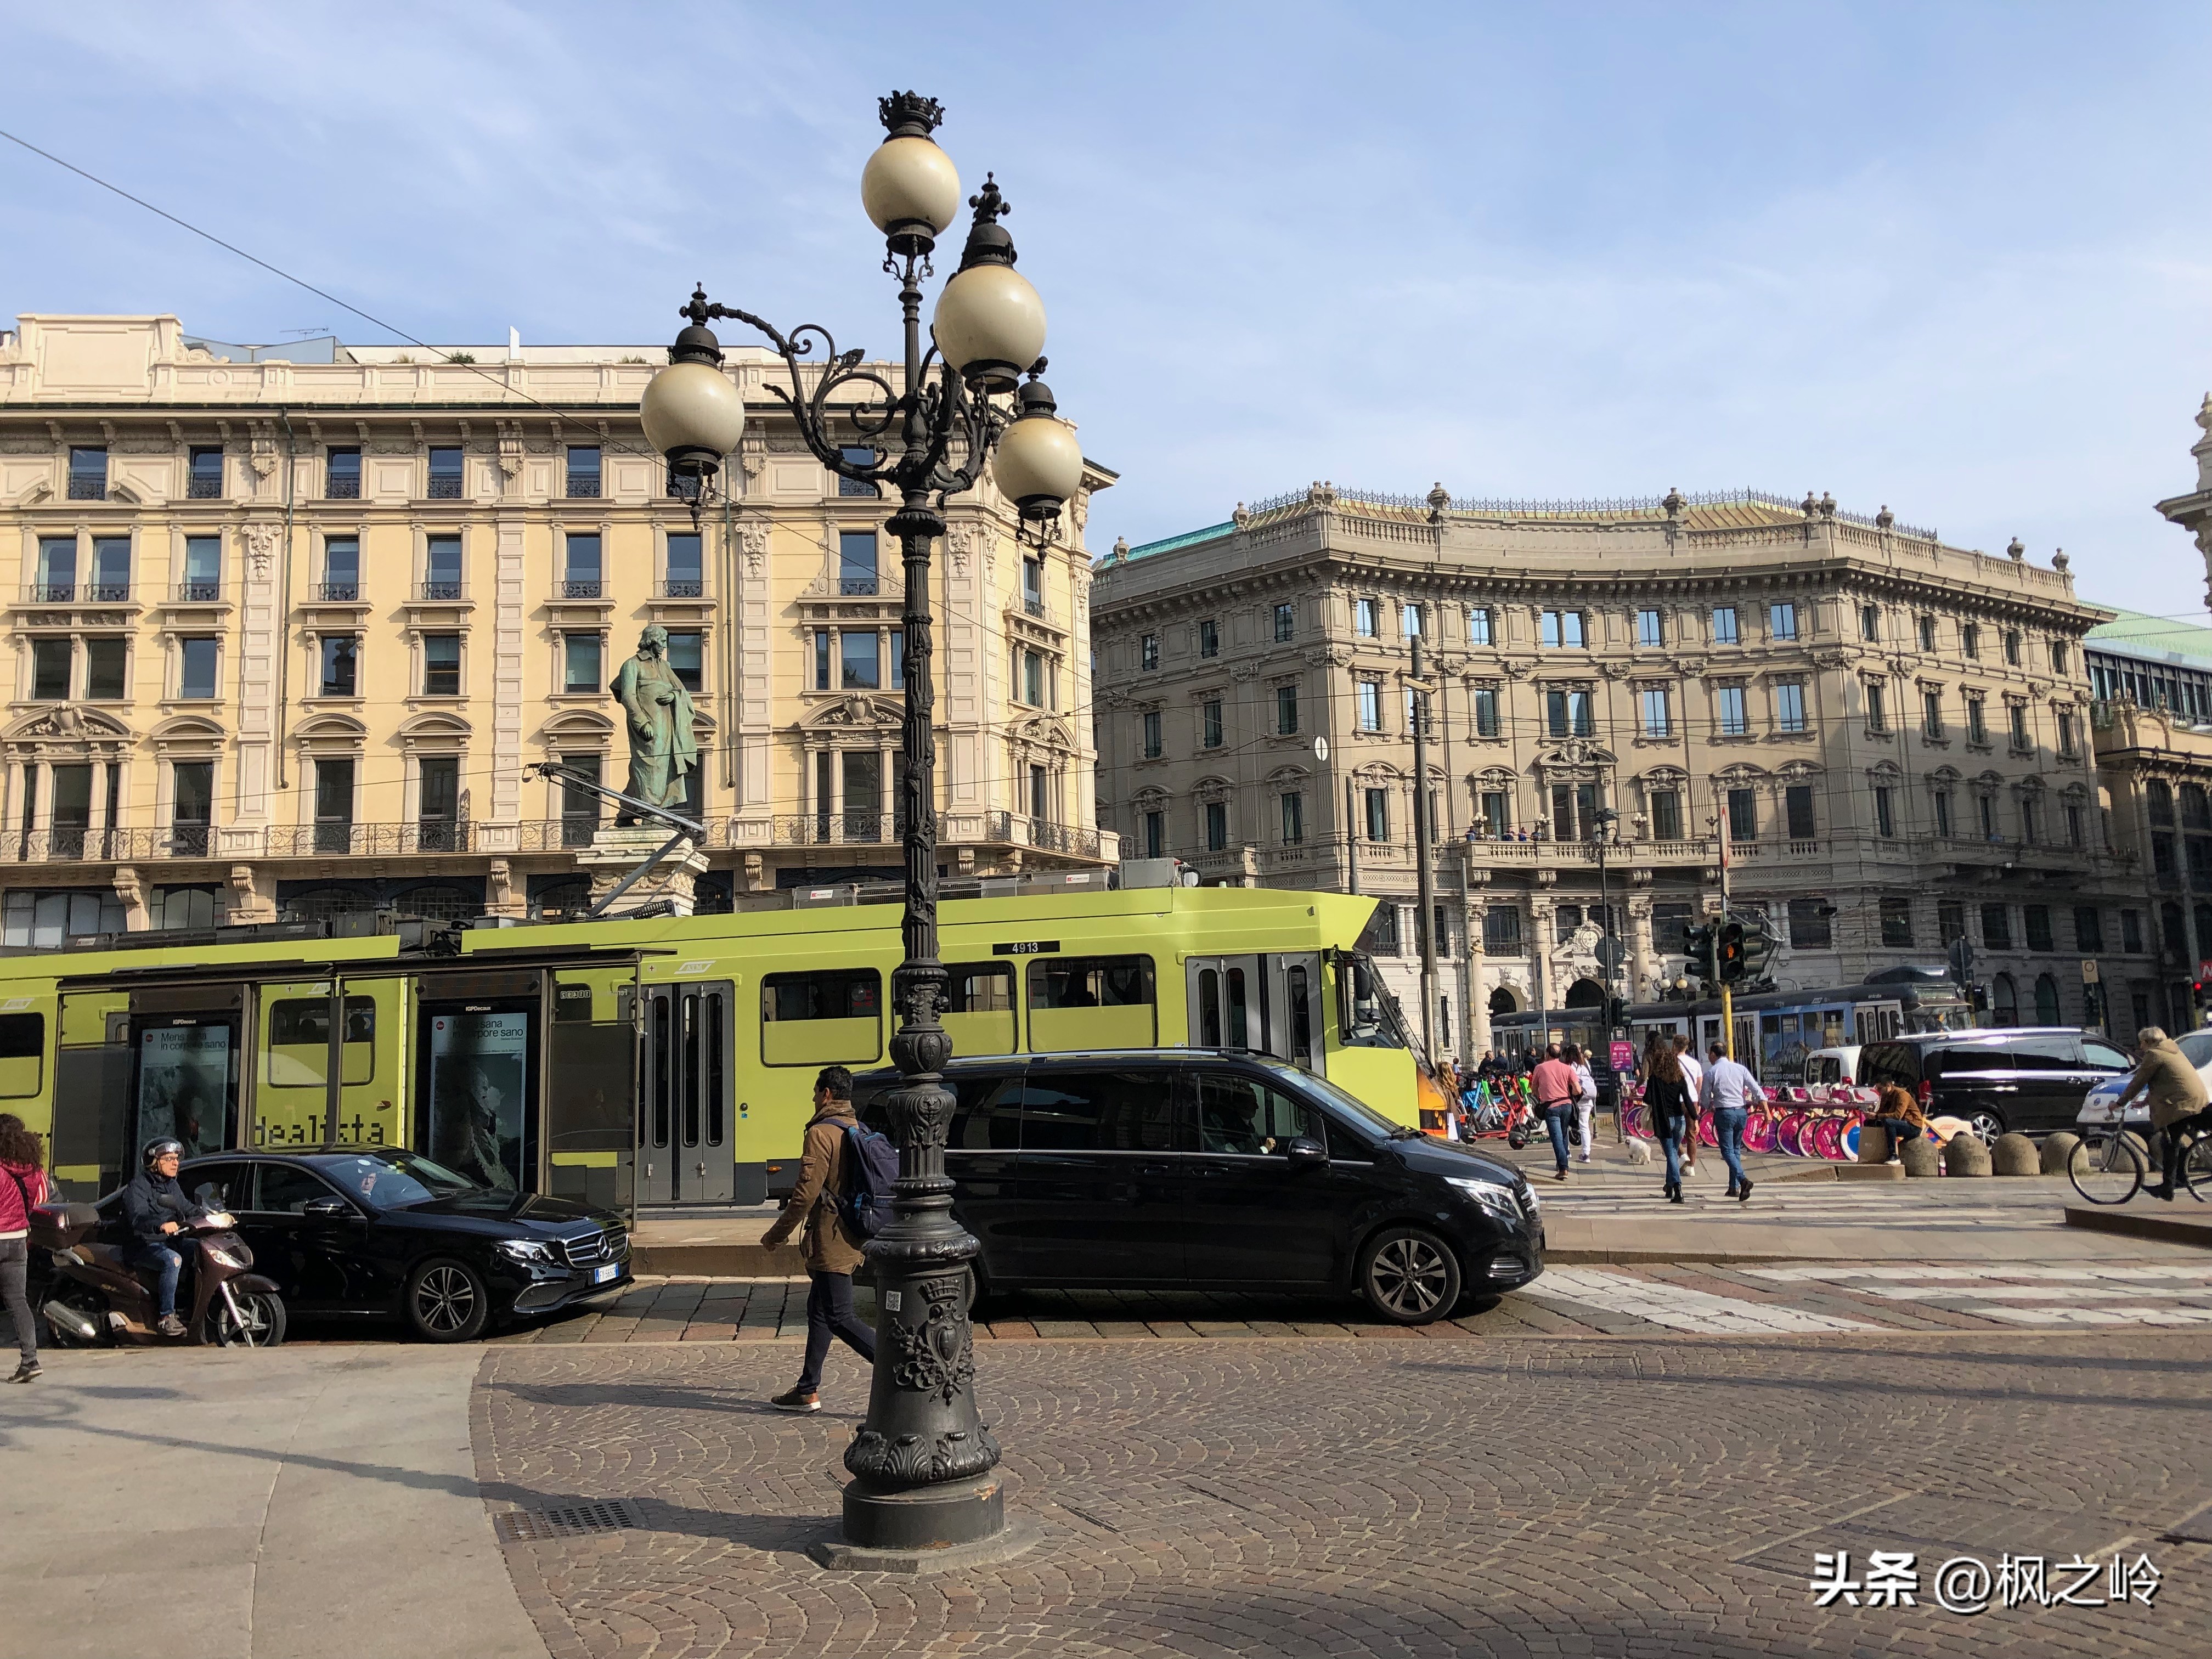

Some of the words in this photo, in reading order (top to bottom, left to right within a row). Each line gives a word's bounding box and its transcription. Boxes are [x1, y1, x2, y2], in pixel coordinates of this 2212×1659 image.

[1012, 942, 1039, 953] 4913
[480, 1020, 503, 1029] sana
[161, 1032, 185, 1042] Mens
[500, 1029, 523, 1037] sano
[205, 1040, 226, 1049] sano
[254, 1114, 384, 1146] dealita
